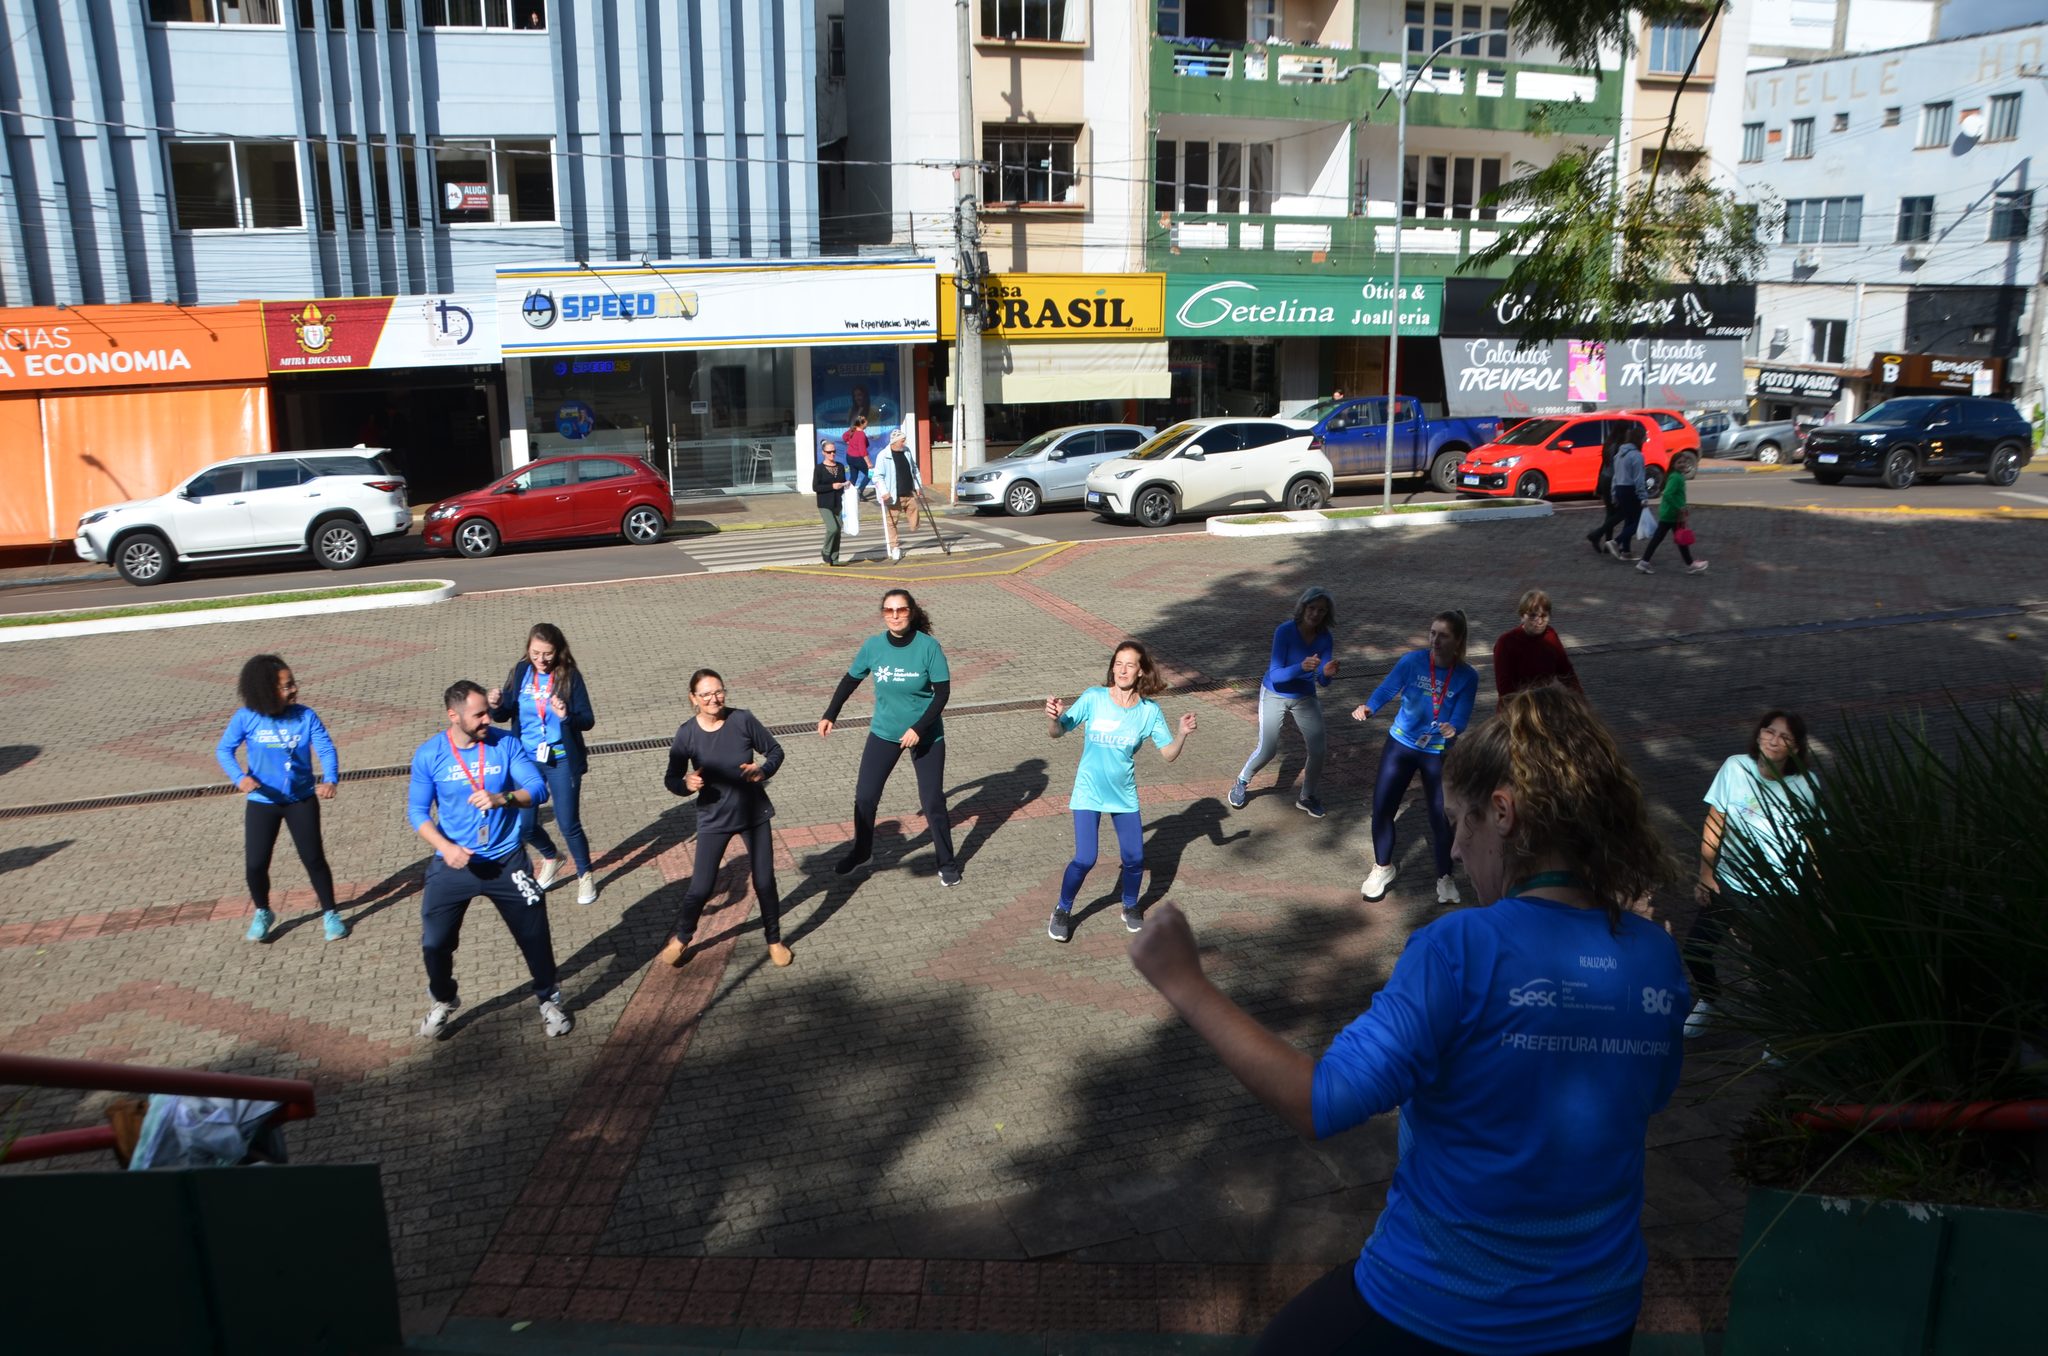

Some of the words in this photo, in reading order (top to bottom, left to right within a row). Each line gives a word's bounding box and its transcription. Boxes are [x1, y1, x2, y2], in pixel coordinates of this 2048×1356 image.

[464, 185, 487, 195] ALUGA
[1411, 284, 1426, 299] &
[0, 327, 71, 350] CIAS
[24, 349, 192, 377] ECONOMIA
[279, 356, 307, 367] MITRA
[308, 354, 352, 366] DIOCESANA
[1458, 367, 1564, 392] TREVISOL
[1760, 371, 1796, 388] FOTO
[1579, 955, 1618, 972] REALIZAÇÃO
[1501, 1032, 1598, 1052] PREFEITURA
